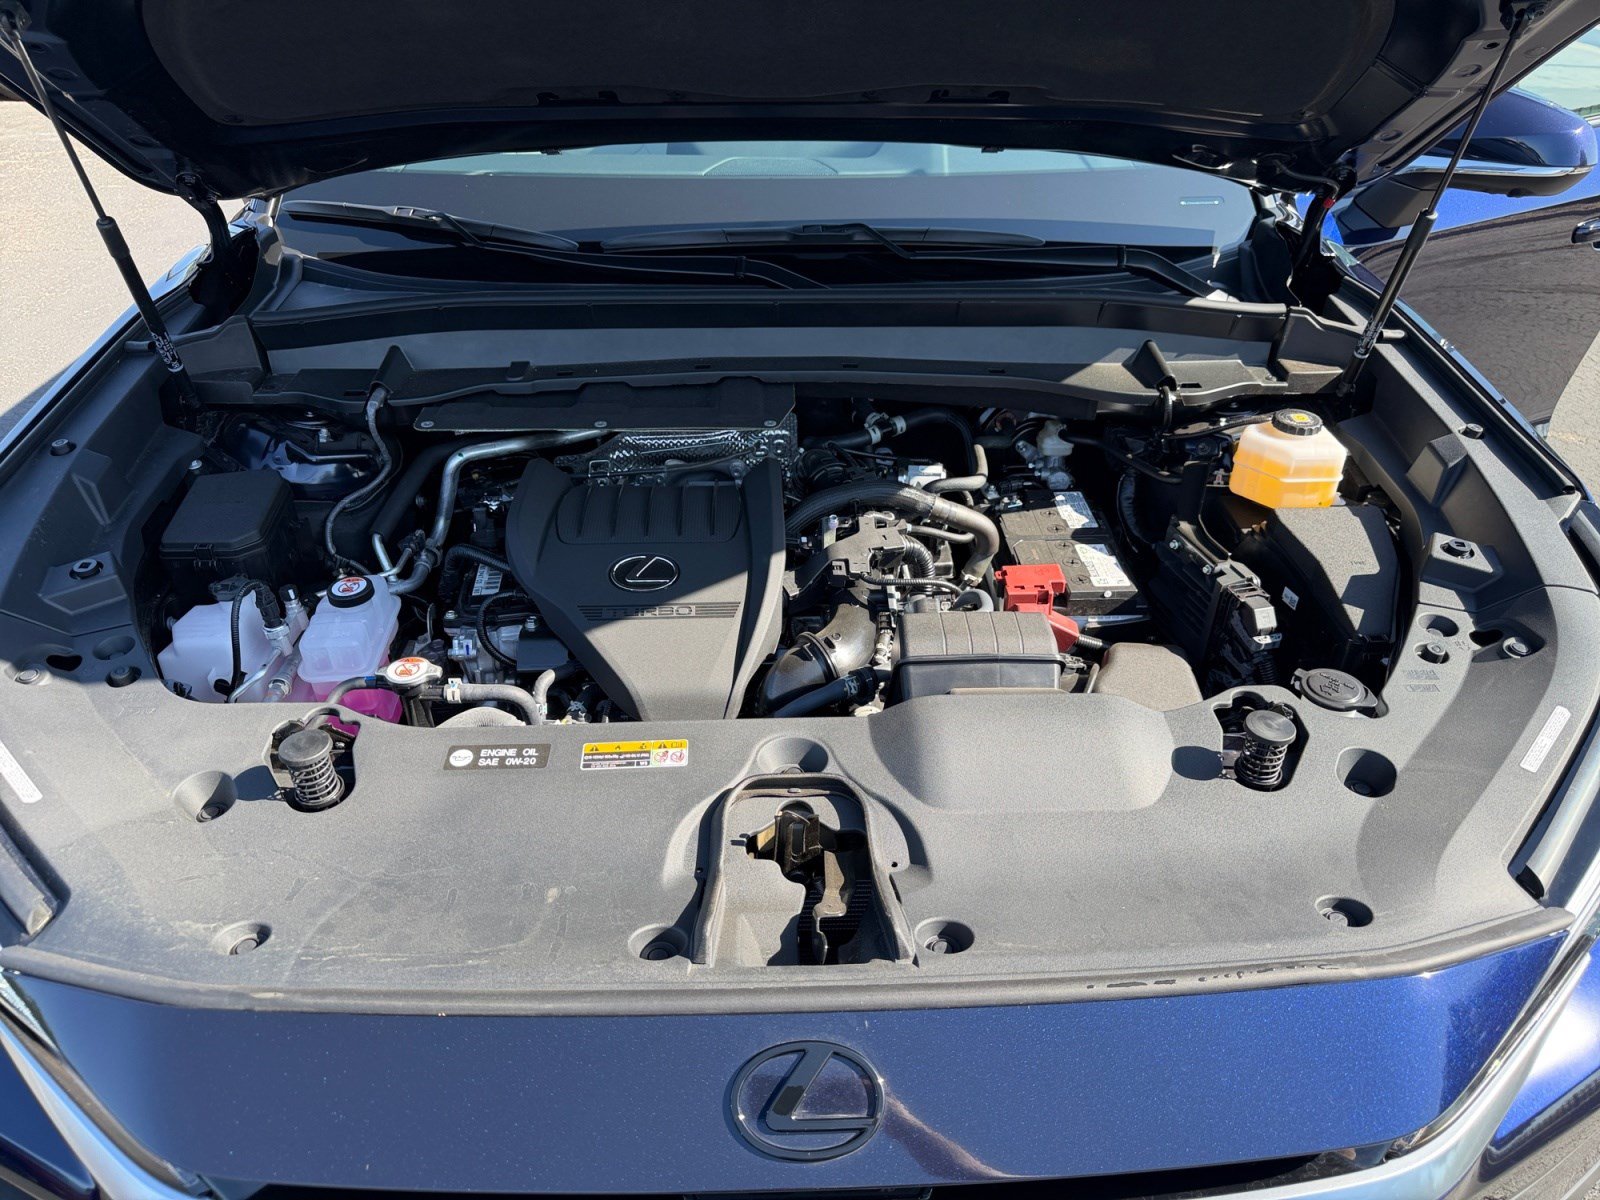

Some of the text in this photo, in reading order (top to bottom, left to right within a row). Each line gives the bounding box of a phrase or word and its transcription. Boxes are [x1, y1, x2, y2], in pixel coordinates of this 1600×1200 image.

[606, 606, 693, 617] TURBO
[480, 748, 539, 757] ENGINE OIL
[478, 757, 537, 766] SAE 0W-20
